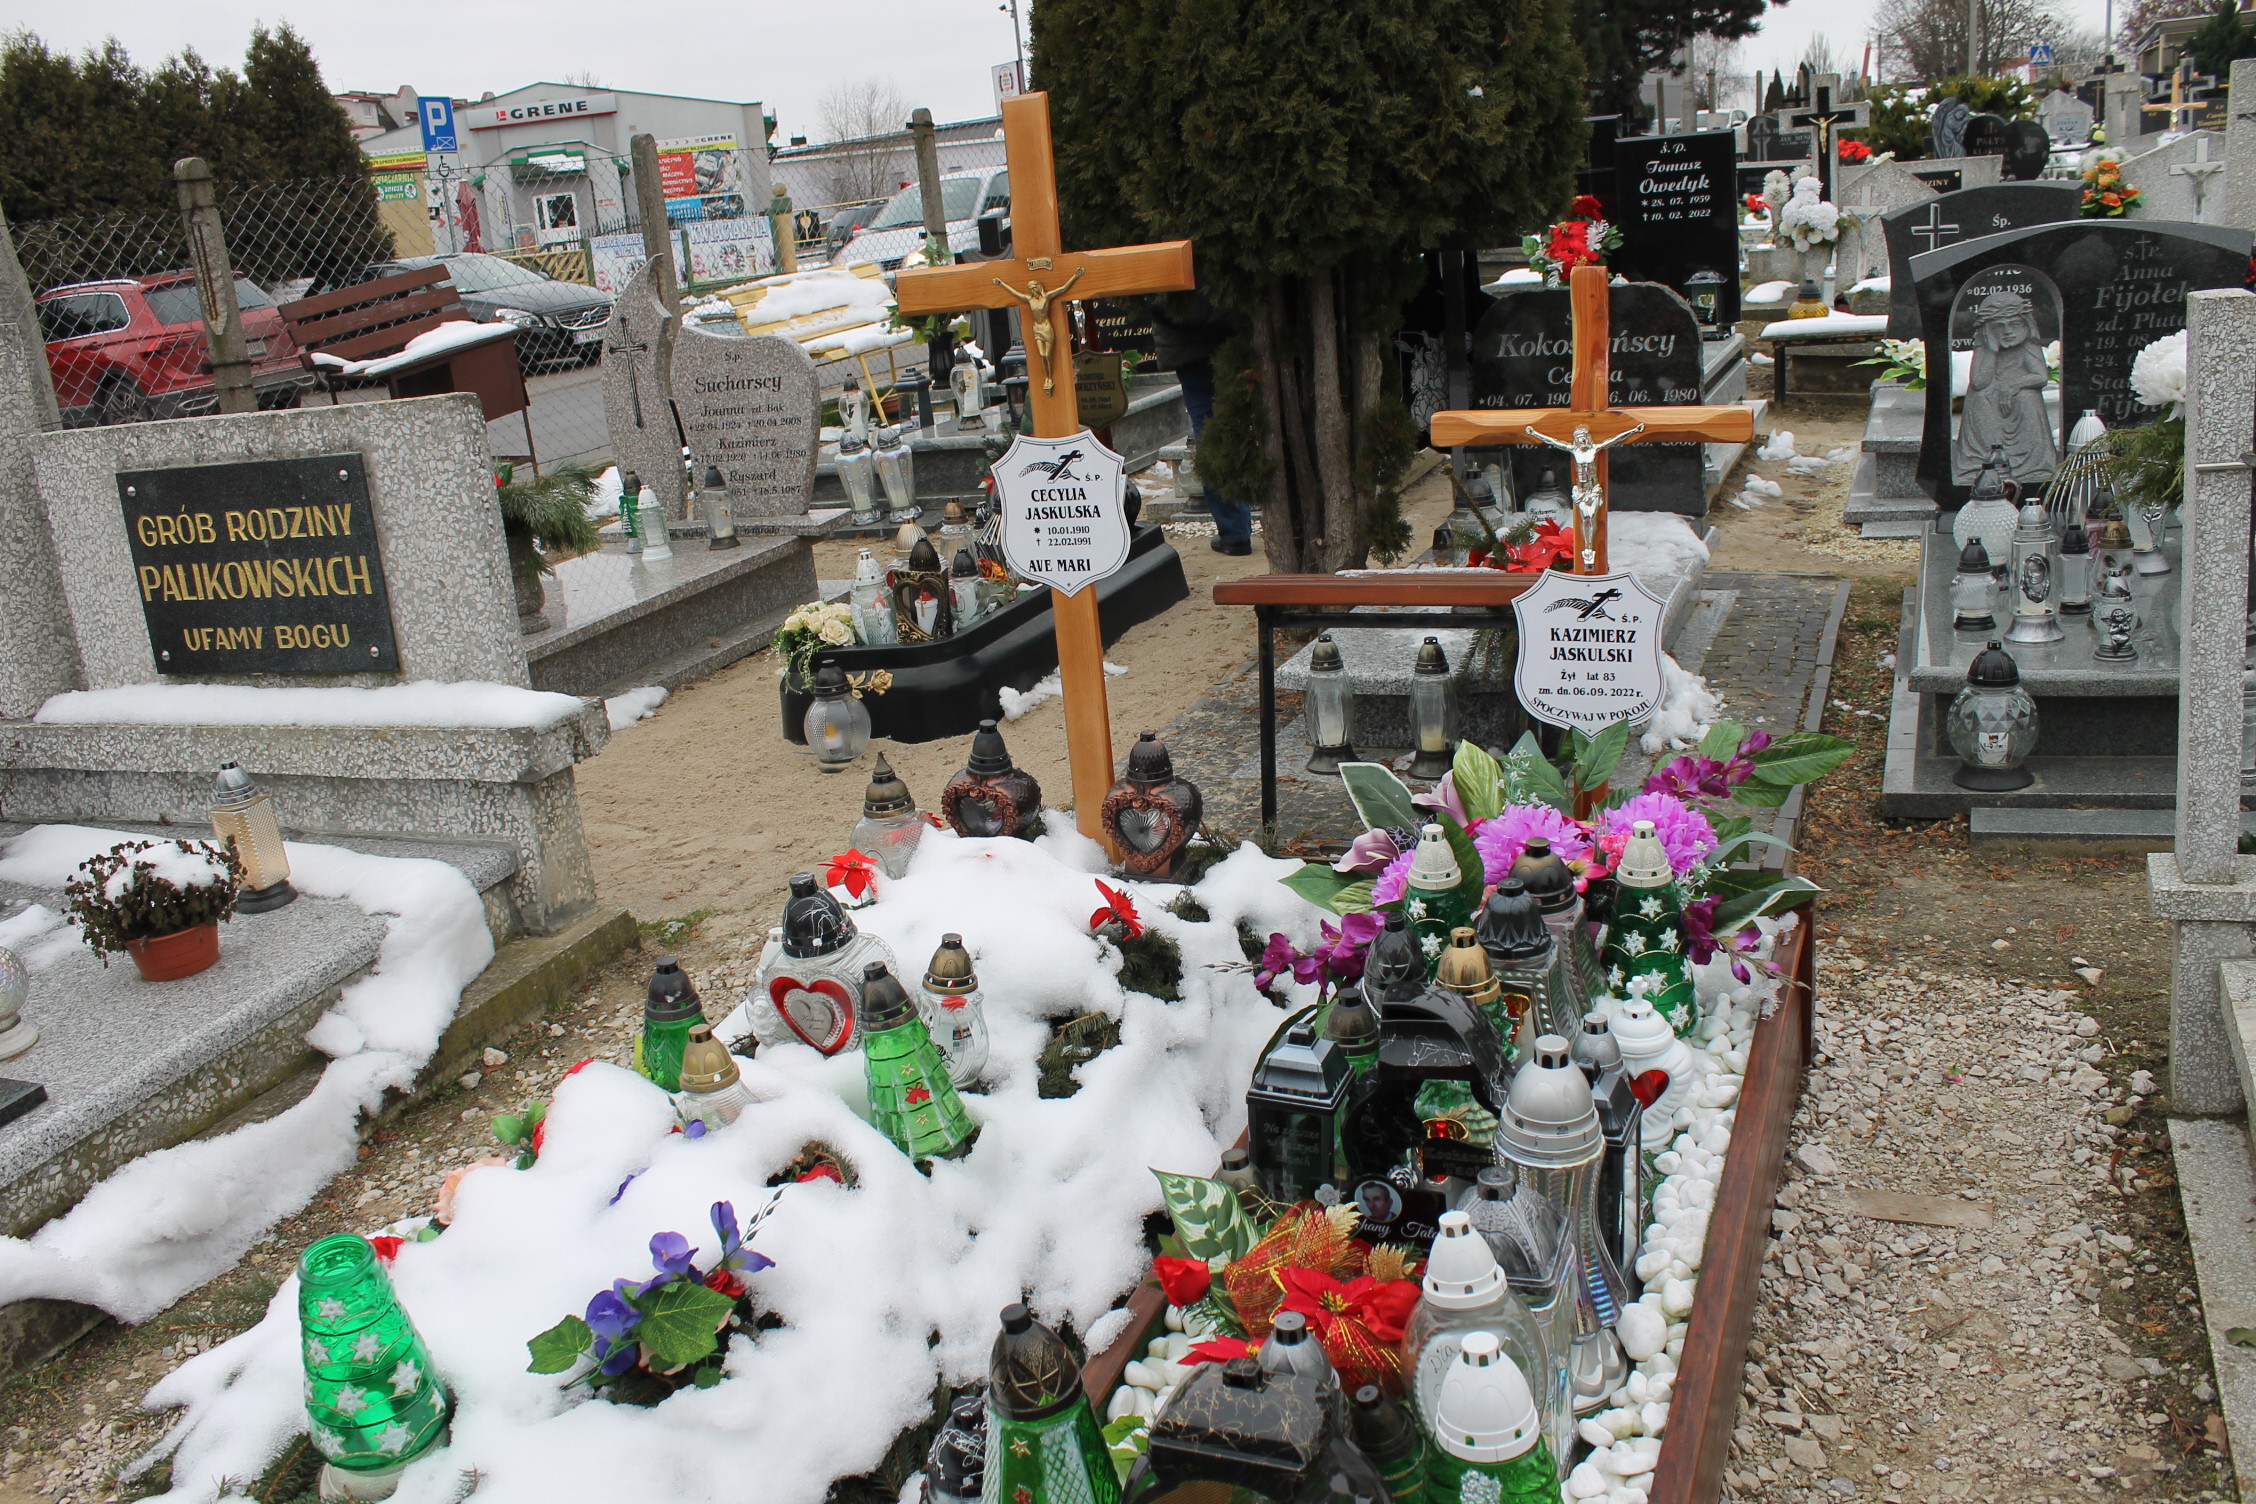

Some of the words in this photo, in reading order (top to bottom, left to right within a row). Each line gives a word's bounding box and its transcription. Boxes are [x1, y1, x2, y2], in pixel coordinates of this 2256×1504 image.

[510, 100, 588, 119] GRENE
[425, 101, 447, 136] P
[701, 134, 733, 143] GRENE
[1646, 160, 1702, 174] Tomasz
[1639, 173, 1711, 194] Owedyk
[1669, 197, 1684, 205] 07.
[1689, 194, 1711, 204] 1959
[1651, 212, 1664, 221] 10.
[1668, 211, 1683, 219] 02.
[1688, 208, 1711, 218] 2022
[1992, 213, 2011, 228] Śp.
[2114, 264, 2174, 282] Anna
[2095, 314, 2124, 332] zd.
[2095, 336, 2118, 350] 19.
[2095, 354, 2118, 367] 24.
[695, 375, 781, 394] Sucharscy
[1515, 394, 1538, 406] 07.
[1628, 390, 1652, 403] 06.
[1663, 388, 1698, 402] 1980
[719, 437, 777, 450] Kazimierz
[729, 468, 776, 484] Ryszard
[1031, 487, 1087, 502] CECYLIA
[1025, 504, 1101, 520] JASKULSKA
[137, 504, 217, 548] GRÓB
[225, 502, 352, 542] RODZINY
[1047, 525, 1090, 535] 10.01.1910
[1047, 537, 1092, 547] 22.02.1991
[1028, 559, 1053, 572] AVE
[1057, 558, 1091, 572] MARI
[139, 554, 373, 602] PALIKOWSKICH
[183, 625, 263, 652] UFAMY
[274, 623, 351, 649] BOGU
[1550, 627, 1637, 644] KAZIMIERZ
[1550, 647, 1633, 663] JASKULSKI
[1560, 668, 1576, 682] Żył
[1587, 671, 1599, 681] lat
[1603, 672, 1616, 681] 83
[1538, 687, 1553, 695] zm.
[1557, 686, 1571, 696] dn.
[1530, 697, 1594, 722] SPOCZYWAJ
[1596, 713, 1608, 722] W
[1609, 698, 1651, 722] POKOJU
